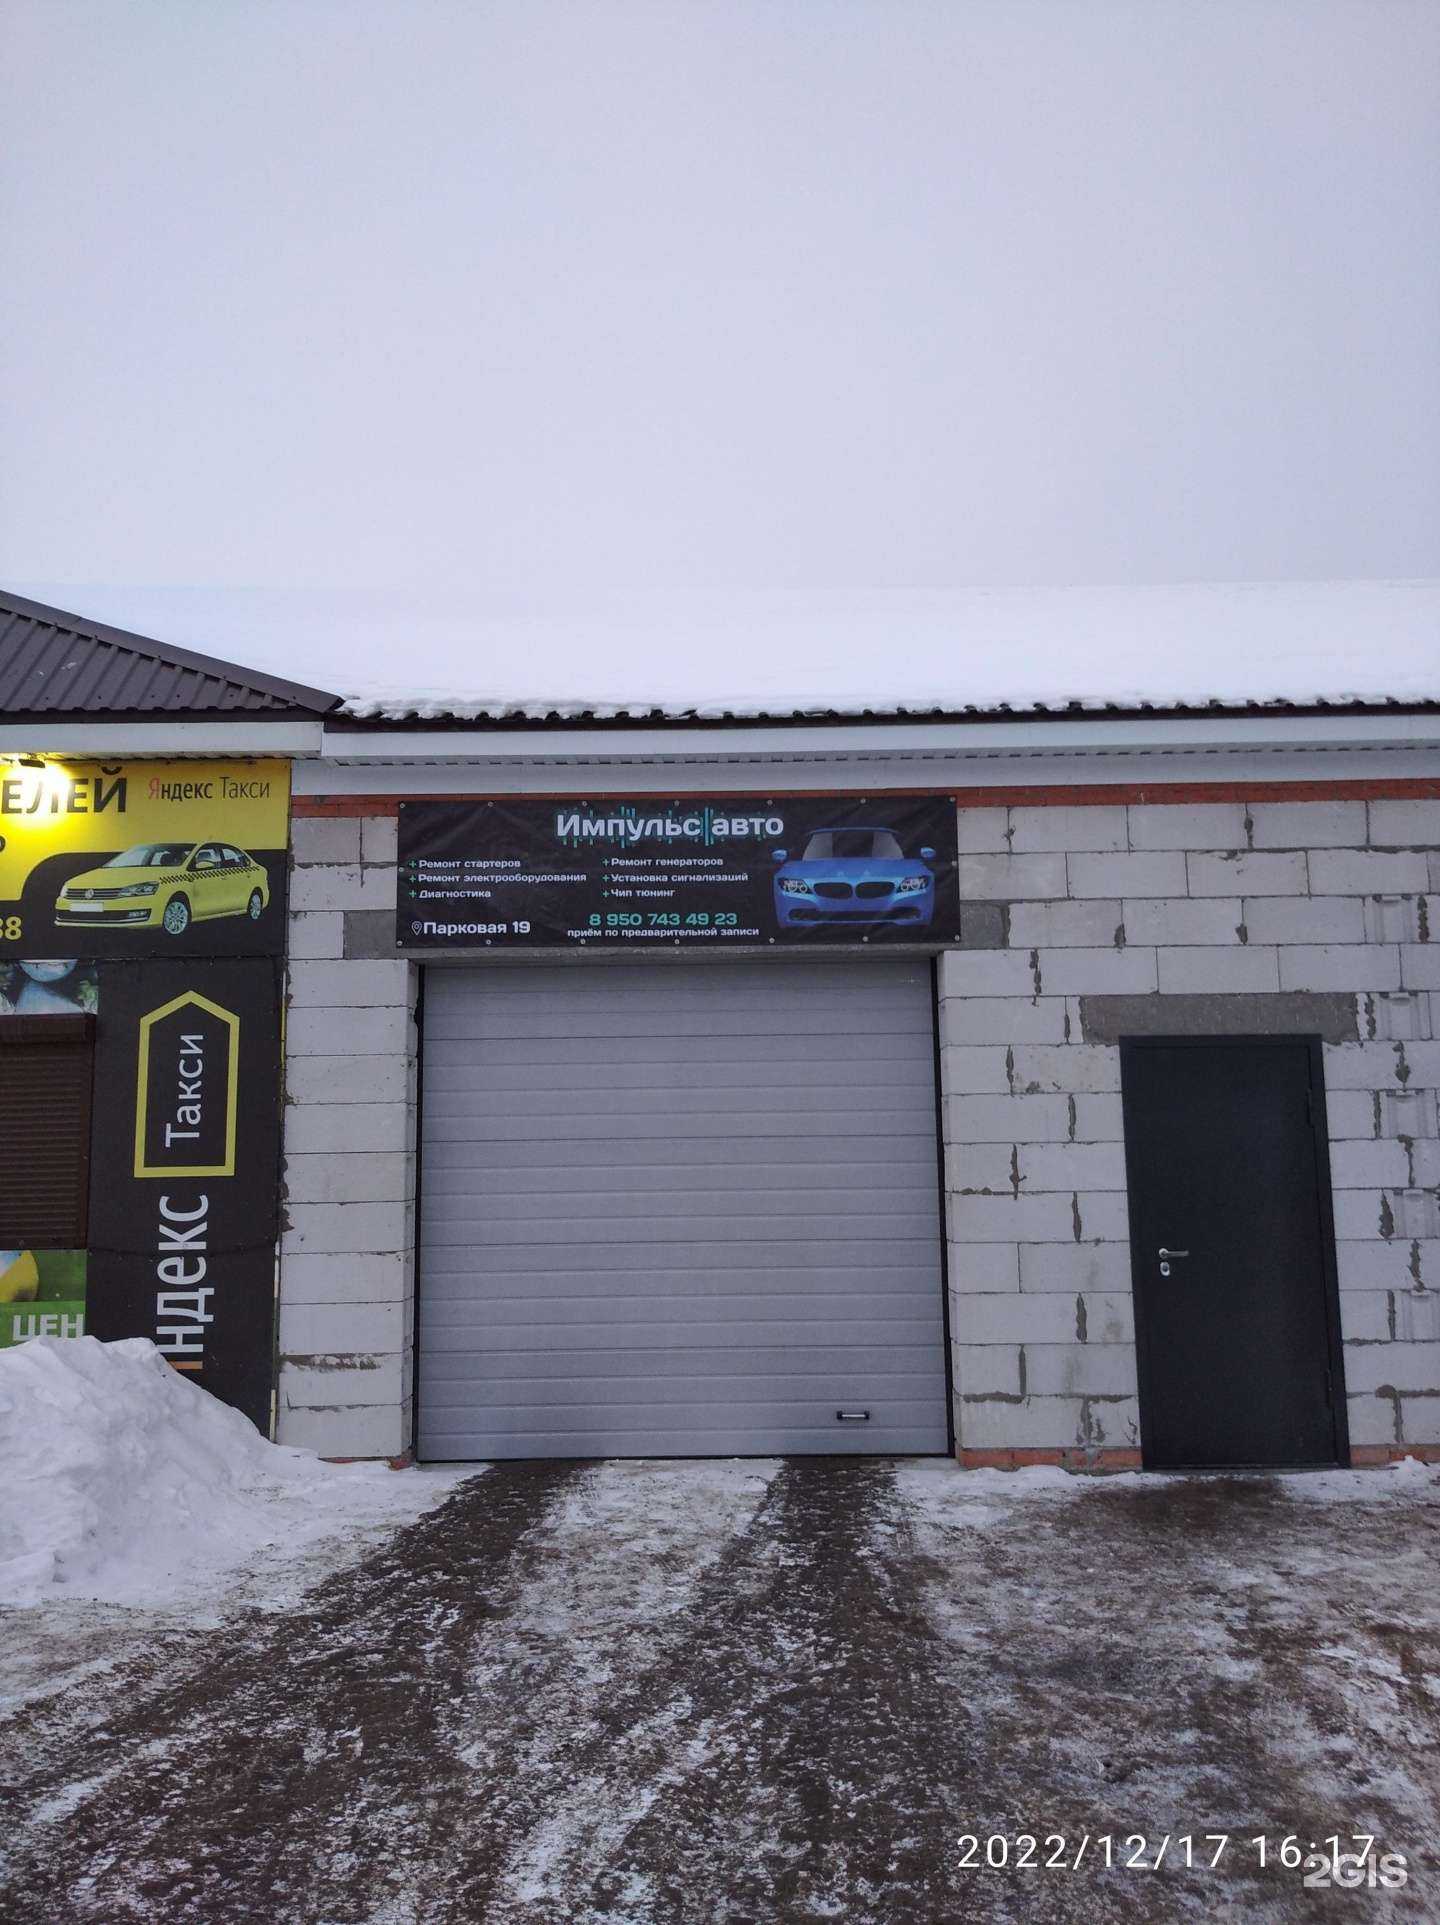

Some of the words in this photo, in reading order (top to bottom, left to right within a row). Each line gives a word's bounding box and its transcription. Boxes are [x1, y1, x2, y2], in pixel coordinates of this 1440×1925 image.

[148, 777, 214, 802] Яндекс
[219, 776, 271, 799] Такси
[556, 814, 701, 841] Импульс
[711, 816, 785, 836] авто
[418, 859, 462, 869] Ремонт
[464, 859, 521, 870] стартеров
[610, 857, 652, 867] Ремонт
[655, 857, 724, 867] генераторов
[418, 873, 461, 883] Ремонт
[463, 873, 588, 884] электрооборудования
[610, 873, 669, 883] Установка
[671, 872, 749, 882] сигнализаций
[418, 889, 492, 899] Диагностика
[610, 889, 633, 897] Чип
[635, 889, 676, 898] тюнинг
[588, 913, 601, 926] 8
[606, 913, 643, 926] 950
[648, 912, 681, 926] 743
[685, 912, 710, 926] 49
[714, 912, 738, 926] 23
[423, 921, 508, 936] Парковая
[512, 921, 532, 934] 19
[567, 929, 602, 938] приём
[604, 929, 619, 937] по
[621, 927, 718, 938] предварительной
[720, 928, 760, 937] записи
[165, 1033, 204, 1148] Такси
